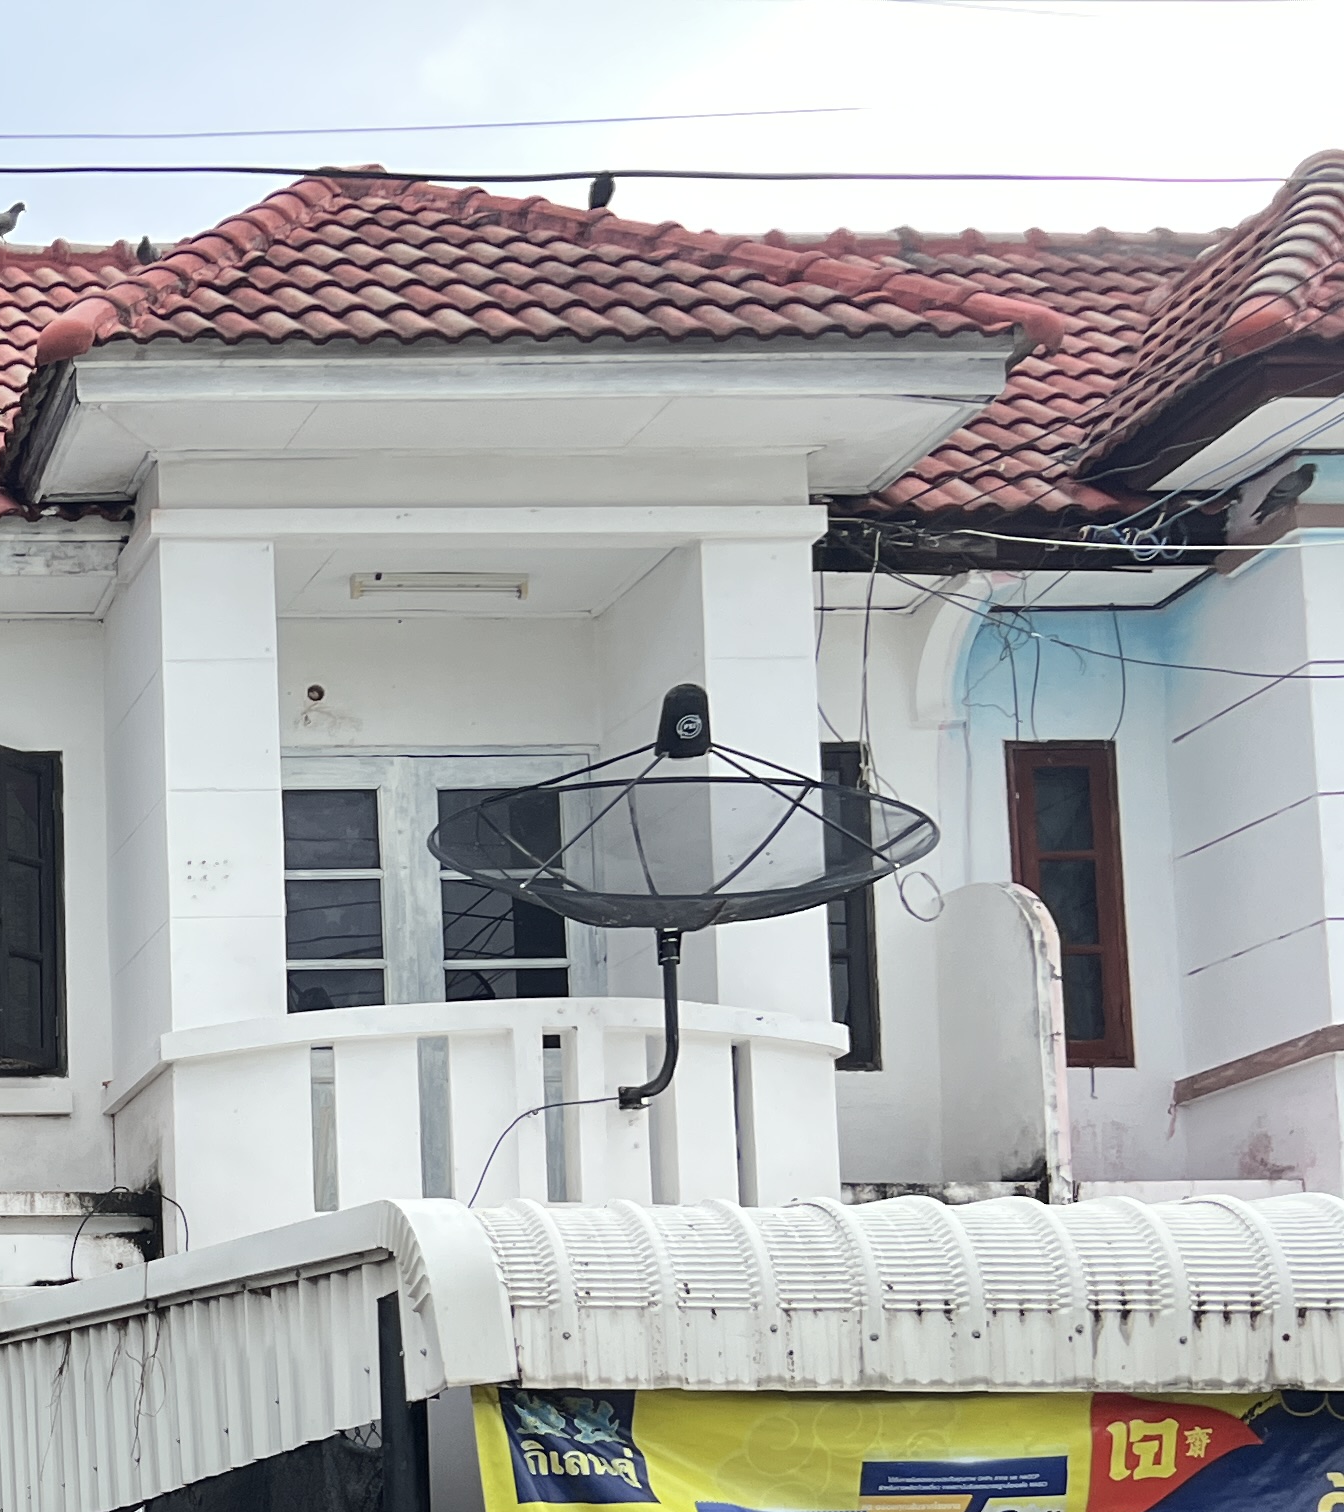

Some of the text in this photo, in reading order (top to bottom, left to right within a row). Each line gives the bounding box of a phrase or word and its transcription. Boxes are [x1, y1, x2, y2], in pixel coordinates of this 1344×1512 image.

[521, 1440, 642, 1489] กิเลนคู่
[1106, 1417, 1179, 1481] เจ
